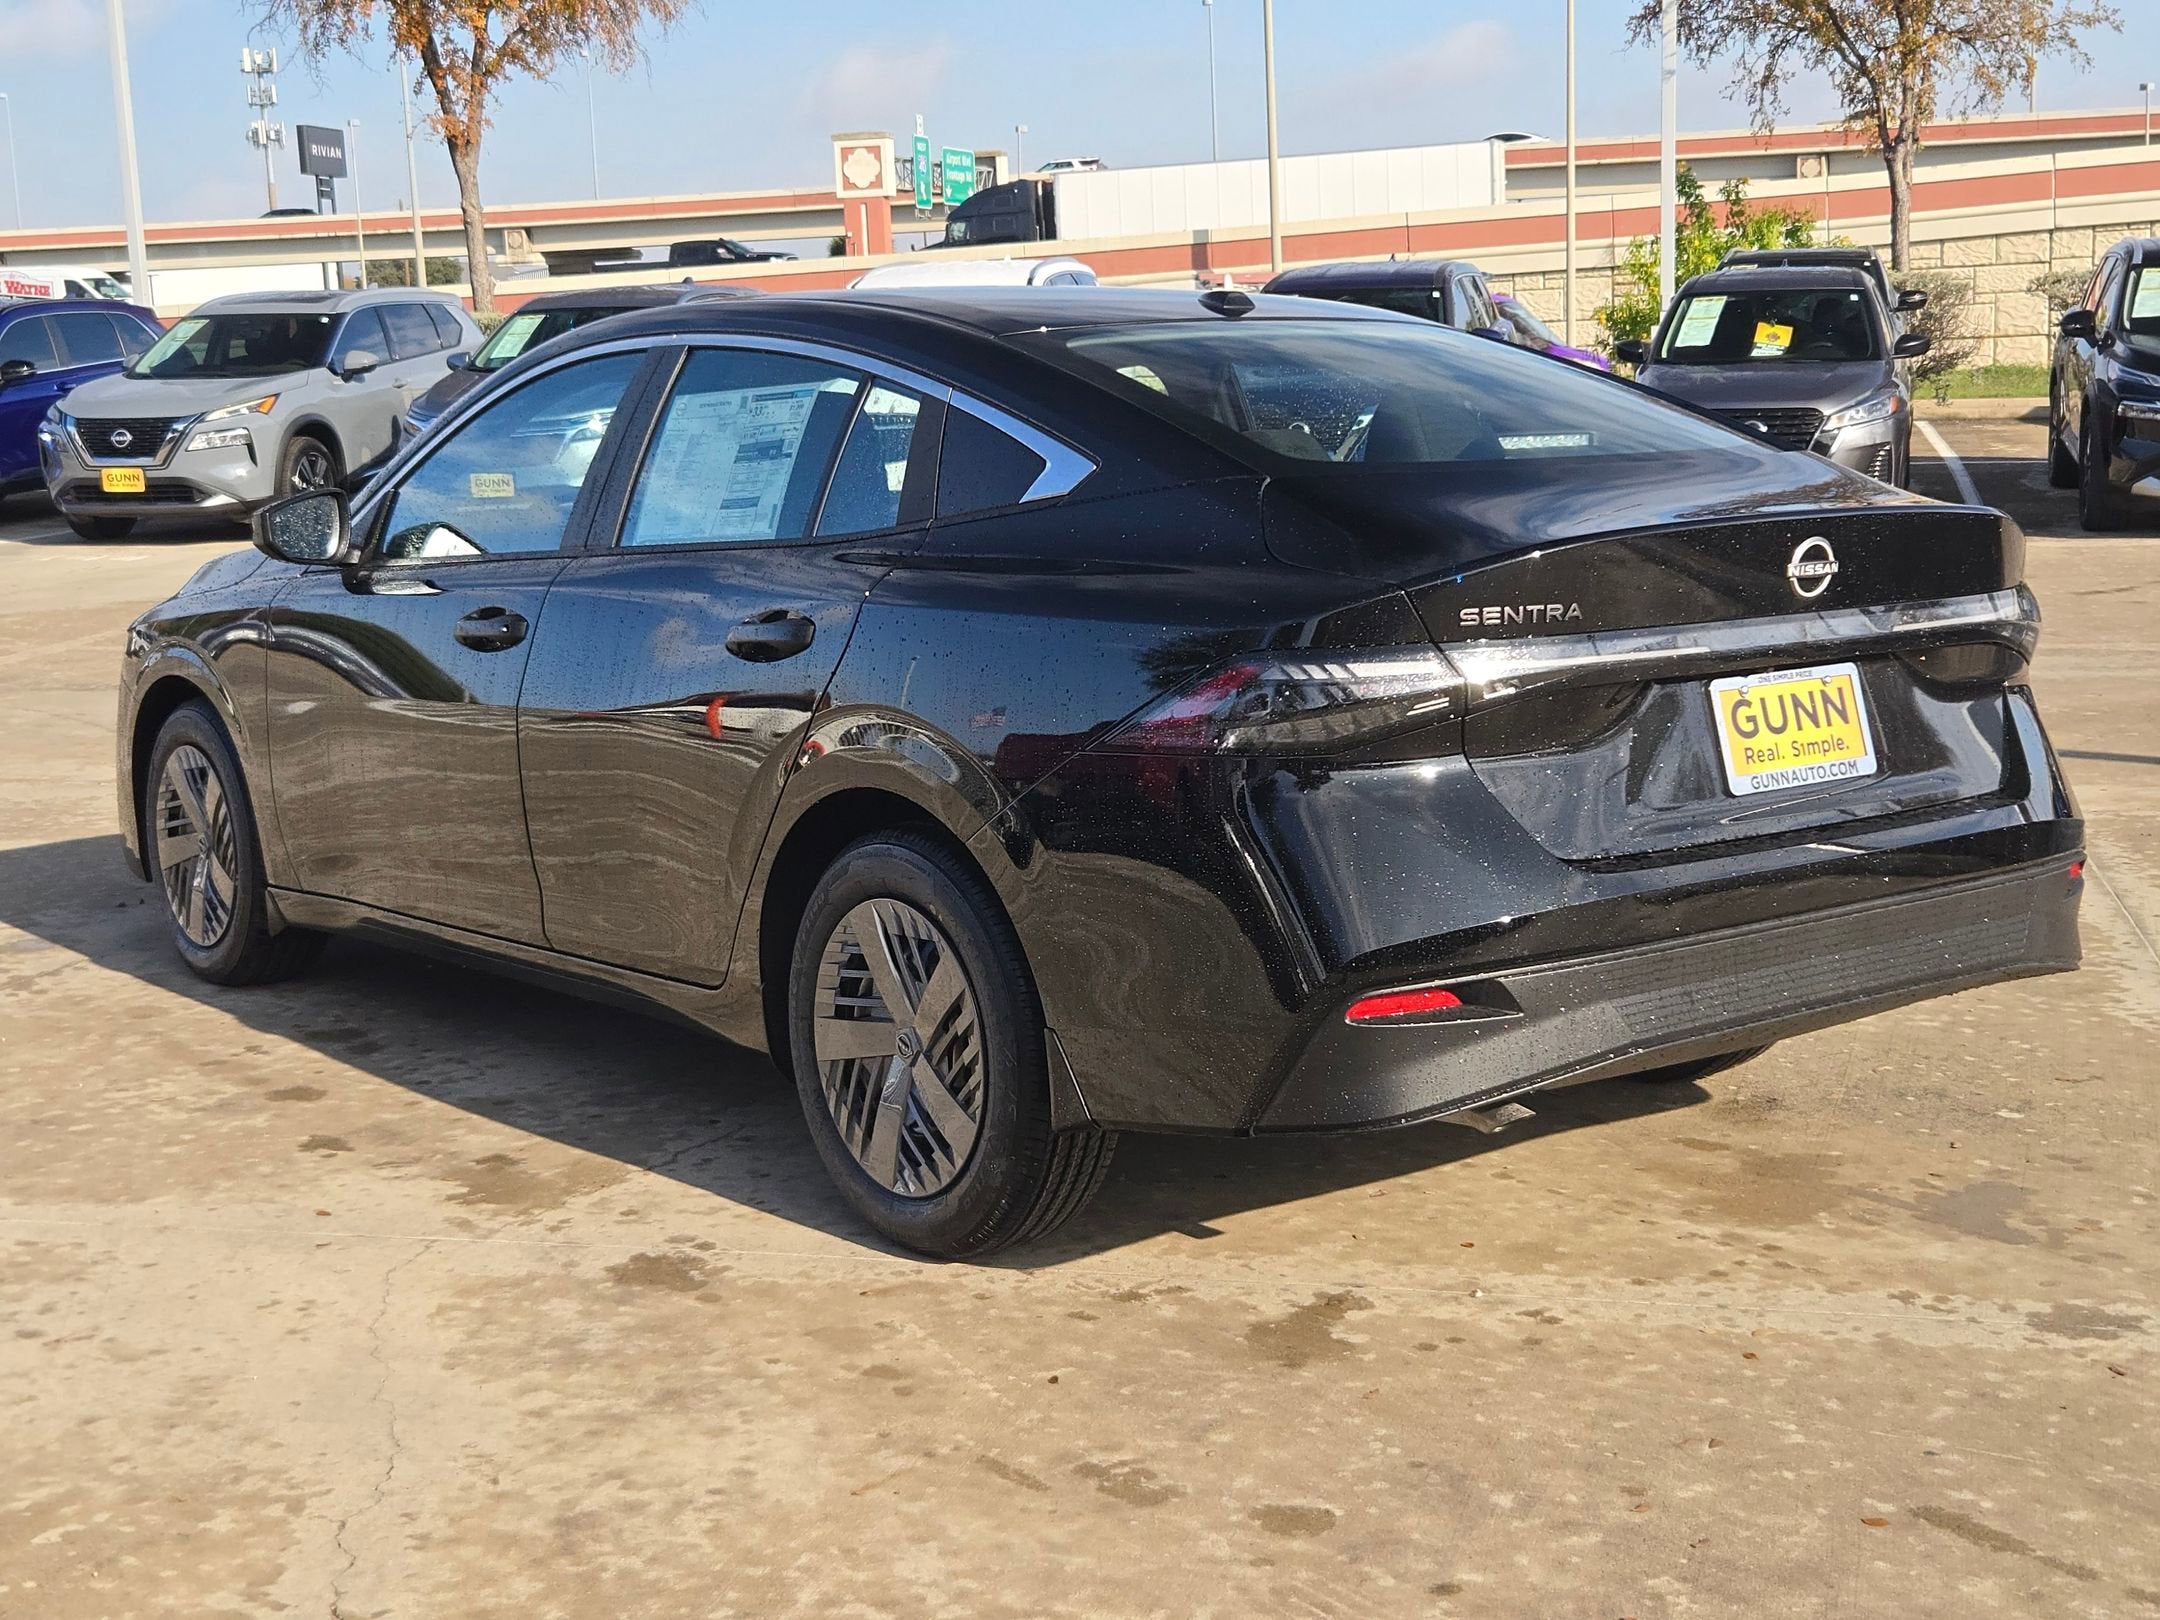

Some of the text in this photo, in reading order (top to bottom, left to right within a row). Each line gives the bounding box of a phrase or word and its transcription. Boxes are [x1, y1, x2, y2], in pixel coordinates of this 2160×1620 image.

[312, 144, 342, 159] RIVIAN
[3, 280, 51, 297] WAYNE
[106, 473, 141, 483] GUNN
[475, 479, 511, 488] GUNN
[1787, 562, 1839, 578] NISSAN
[1459, 602, 1583, 628] SENTRA
[1730, 686, 1851, 740] GUNN
[1744, 734, 1850, 765] Real. Simple.
[1750, 759, 1860, 790] GUNNAUTO.COM
